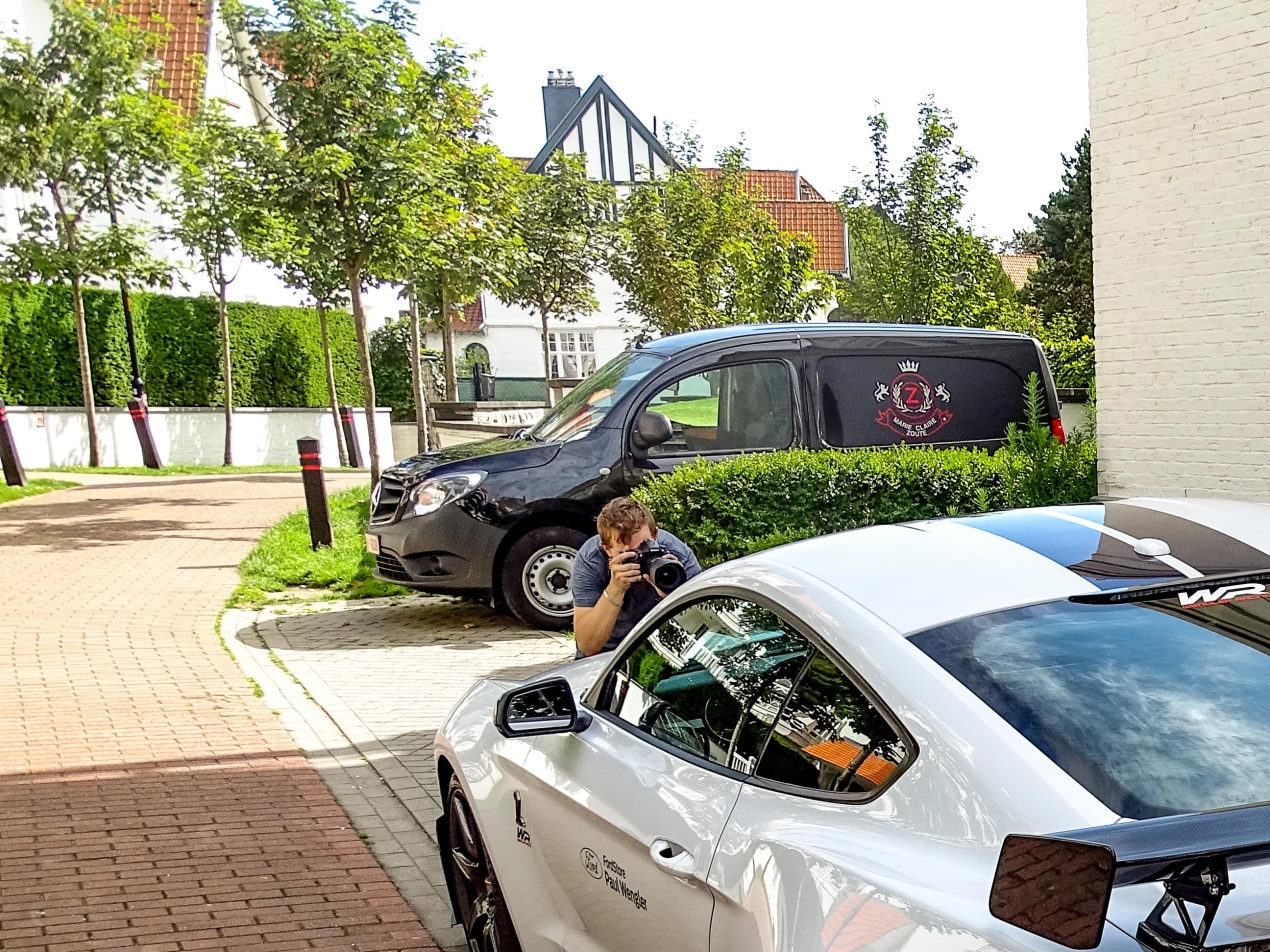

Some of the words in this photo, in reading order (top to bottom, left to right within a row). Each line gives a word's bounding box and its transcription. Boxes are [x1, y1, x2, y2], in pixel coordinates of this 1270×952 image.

[904, 387, 919, 405] Z
[893, 416, 912, 430] MARIE
[915, 417, 938, 431] CLAIRE
[906, 429, 928, 437] ZOUTE
[1177, 583, 1270, 606] WR
[585, 850, 598, 874] Ford
[602, 854, 626, 879] FordStore
[604, 870, 621, 894] Paul
[619, 879, 648, 911] Wengler
